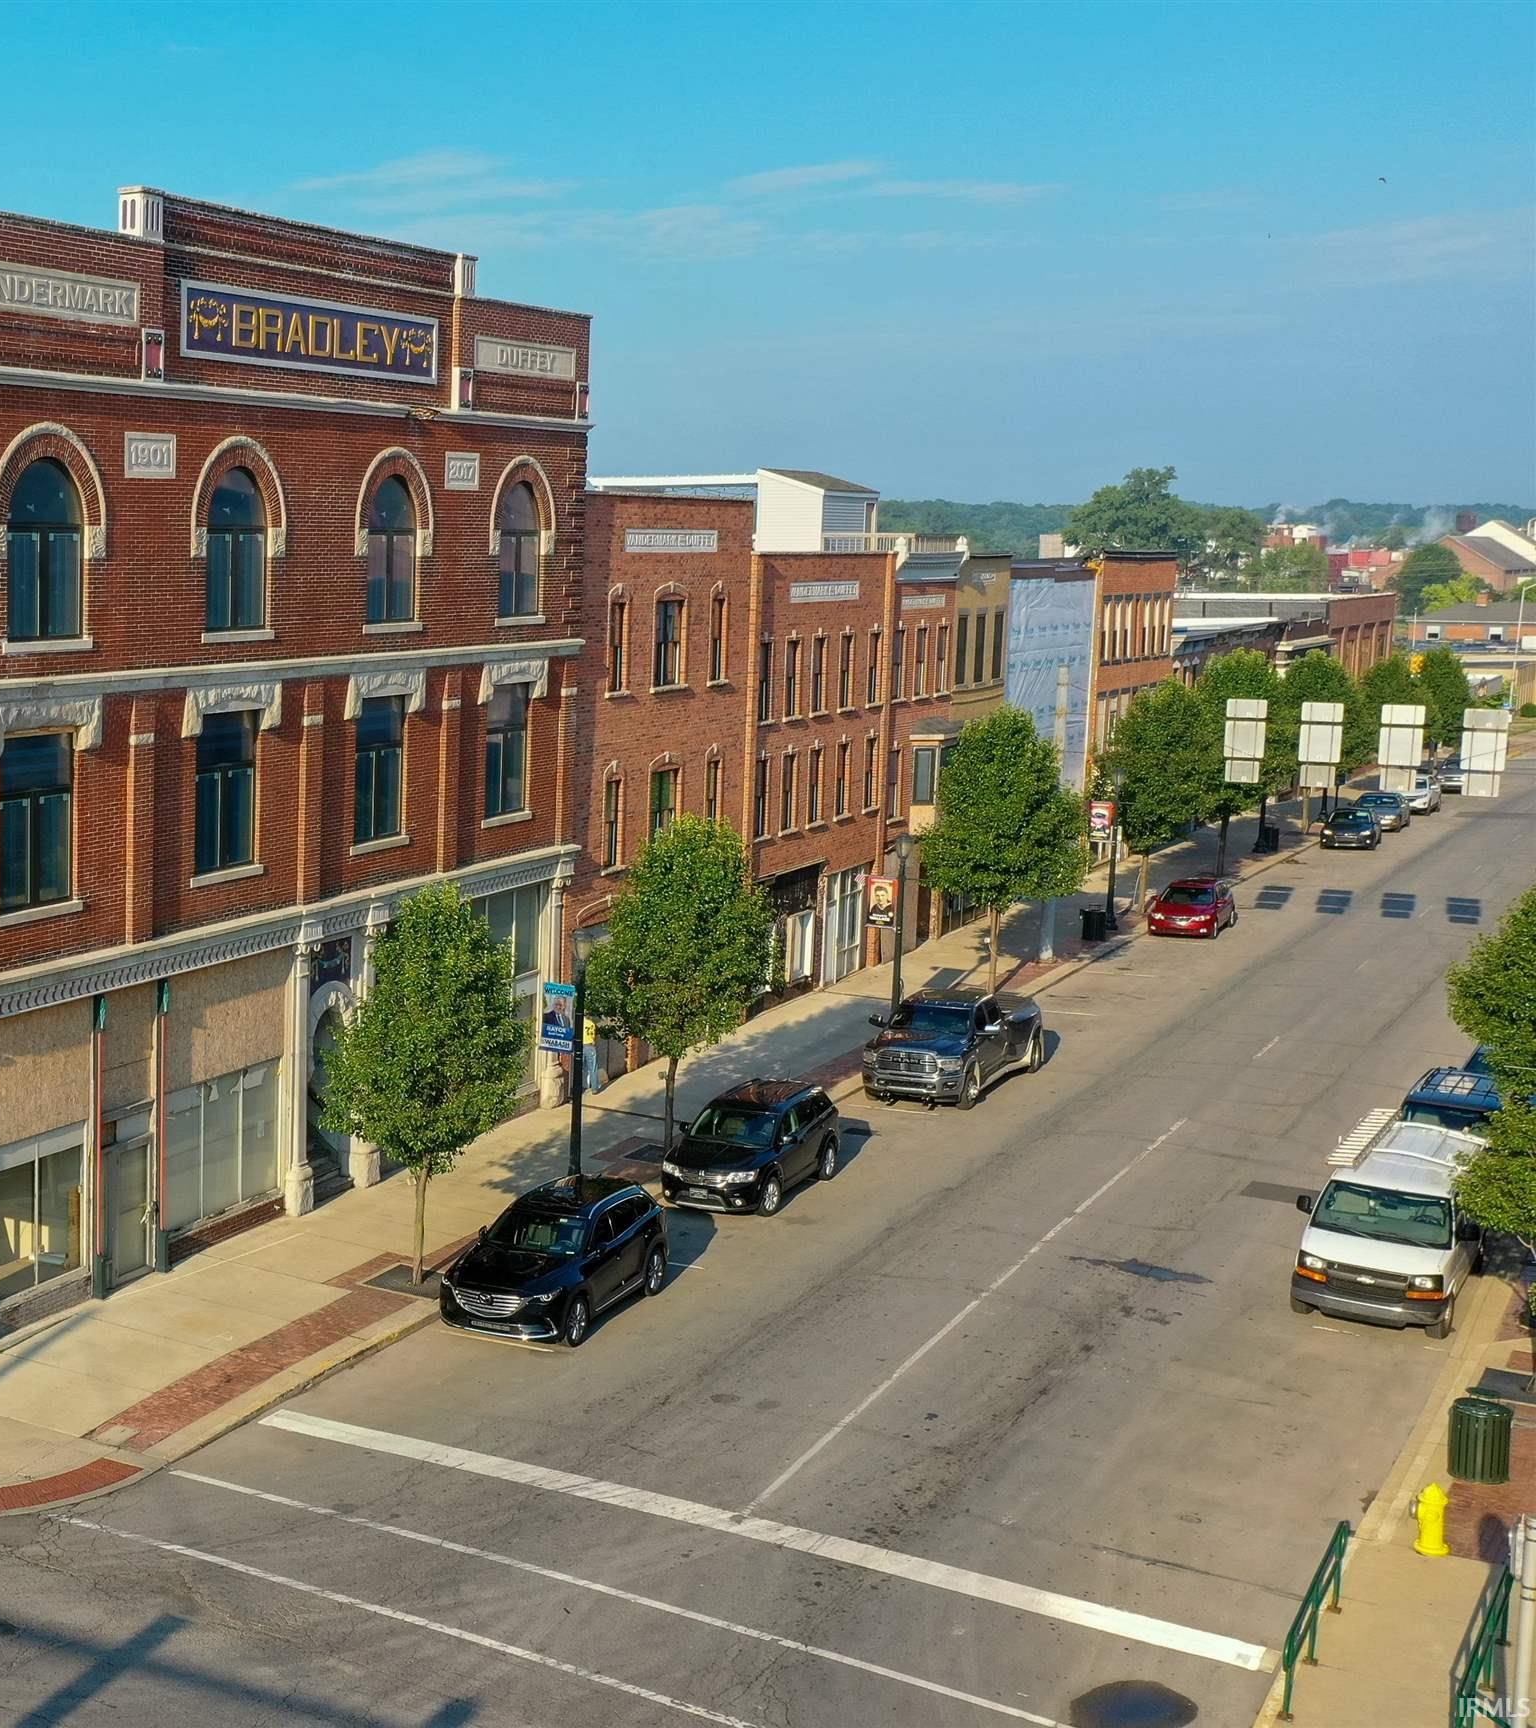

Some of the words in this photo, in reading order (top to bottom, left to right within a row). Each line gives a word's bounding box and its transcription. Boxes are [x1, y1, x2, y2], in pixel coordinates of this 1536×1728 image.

[232, 303, 400, 366] BRADLEY
[497, 346, 555, 371] DUFFEY
[130, 442, 169, 466] 1901
[449, 460, 475, 480] 2017
